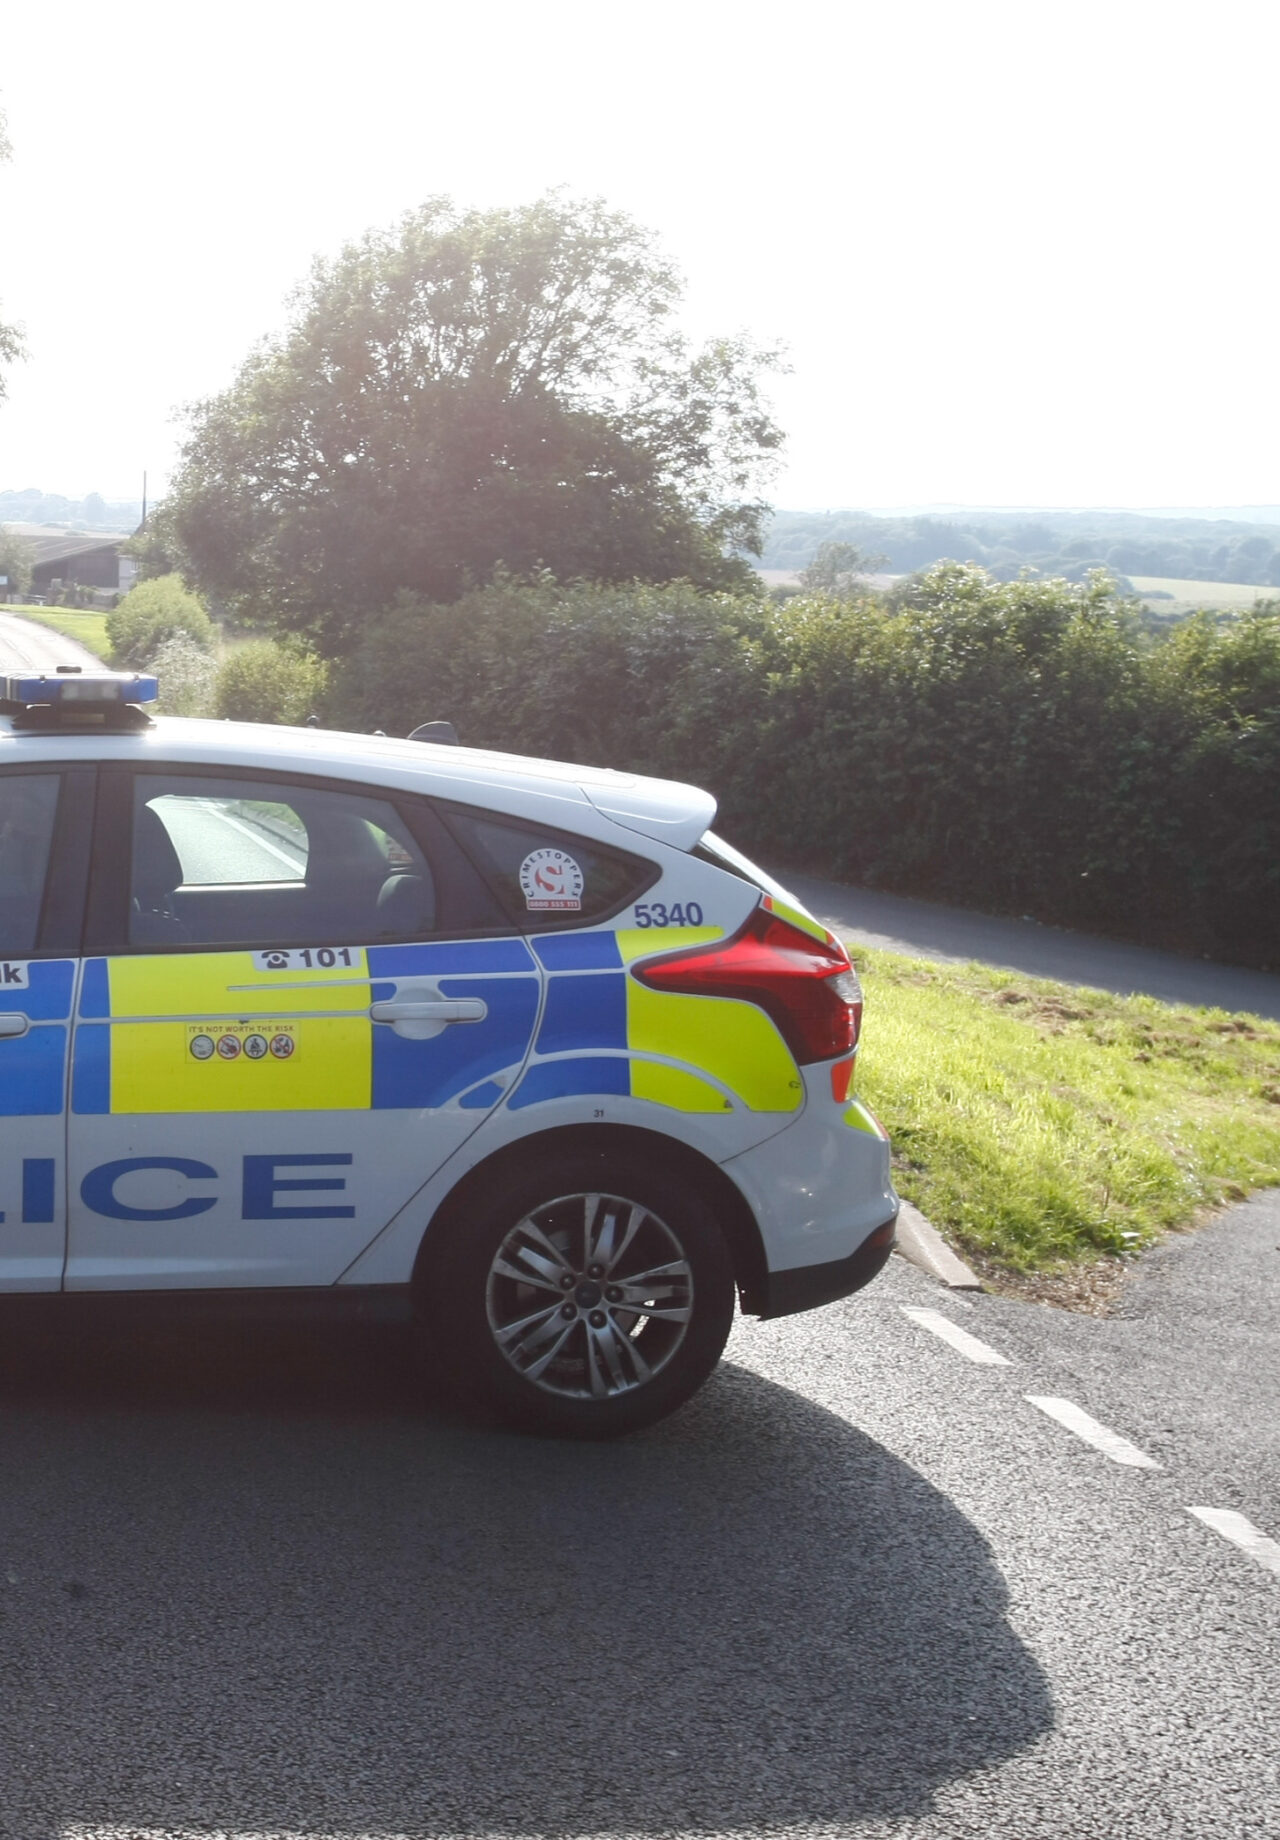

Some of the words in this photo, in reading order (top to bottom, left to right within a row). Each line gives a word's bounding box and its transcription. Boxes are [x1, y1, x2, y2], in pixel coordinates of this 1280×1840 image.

[521, 850, 581, 898] CRIMESTOPPERS
[634, 902, 703, 928] 5340
[299, 948, 352, 968] 101
[206, 1025, 223, 1033] NOT
[225, 1025, 254, 1033] WORTH
[275, 1024, 295, 1032] RISK
